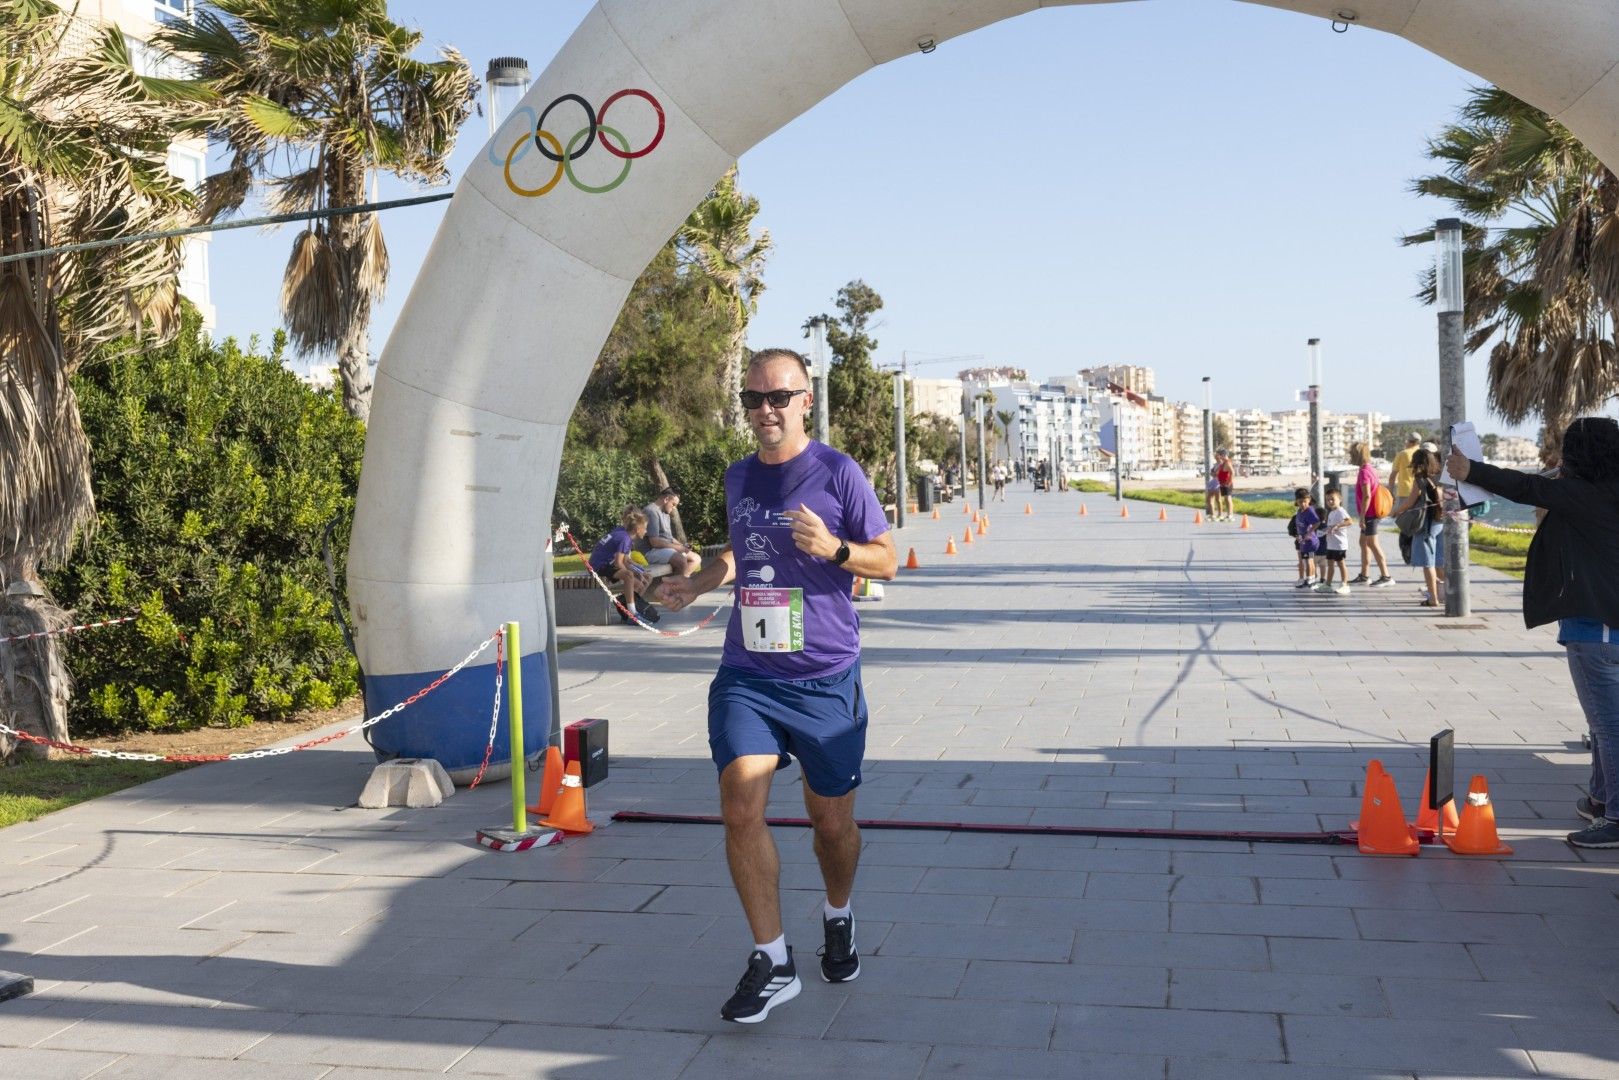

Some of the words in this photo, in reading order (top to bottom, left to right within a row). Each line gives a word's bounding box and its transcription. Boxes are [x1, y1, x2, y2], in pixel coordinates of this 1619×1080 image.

[756, 619, 766, 638] 1
[792, 611, 802, 629] KM
[793, 630, 802, 646] 3,5
